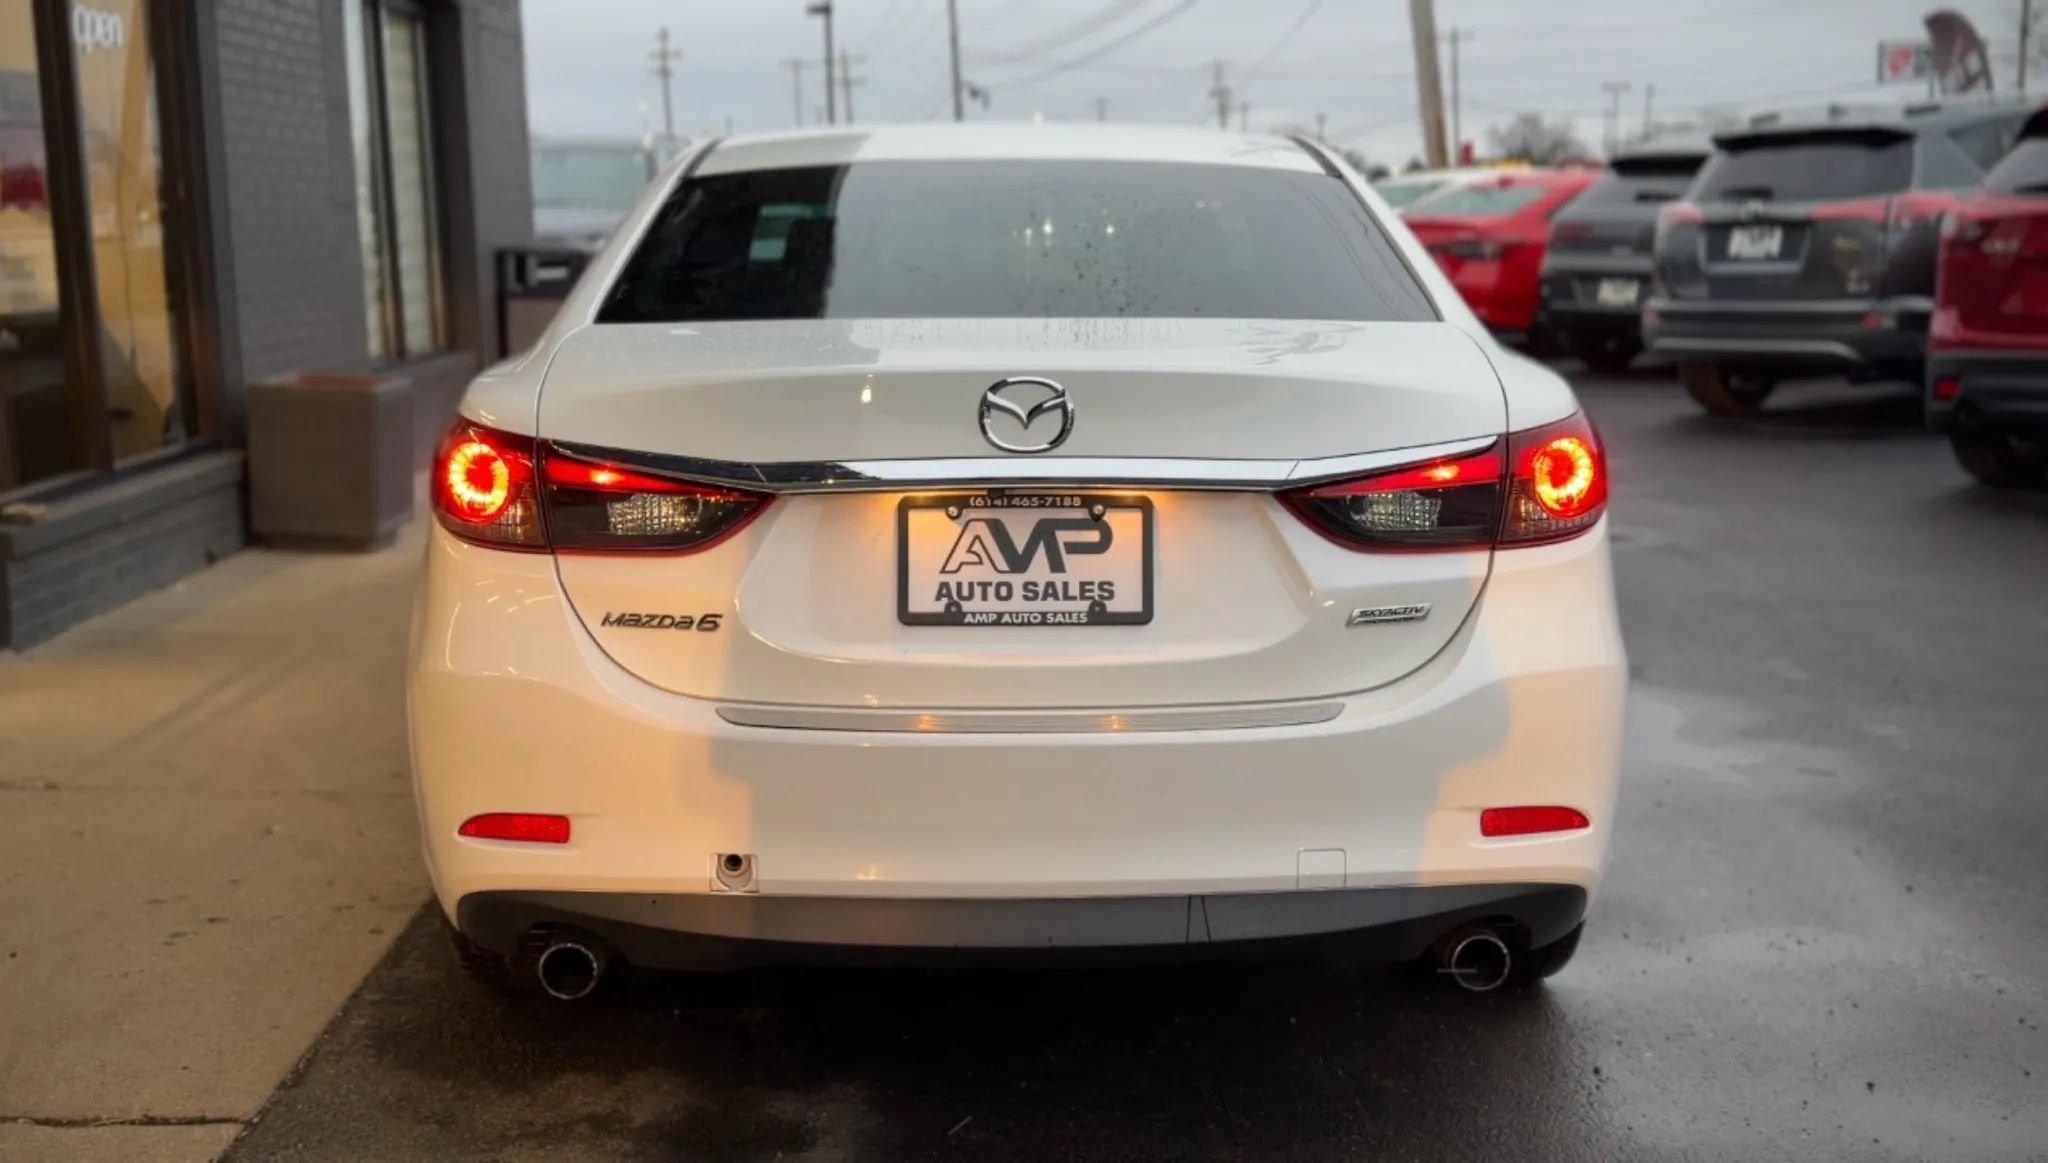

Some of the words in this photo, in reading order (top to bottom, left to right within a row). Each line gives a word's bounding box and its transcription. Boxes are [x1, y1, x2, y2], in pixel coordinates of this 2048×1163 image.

[1011, 496, 1081, 507] 465-7188
[939, 518, 1113, 574] AMP
[935, 580, 1013, 601] AUTO
[1022, 580, 1115, 602] SALES
[963, 612, 998, 624] AMP
[1001, 612, 1042, 624] AUTO
[1046, 612, 1089, 624] SALES
